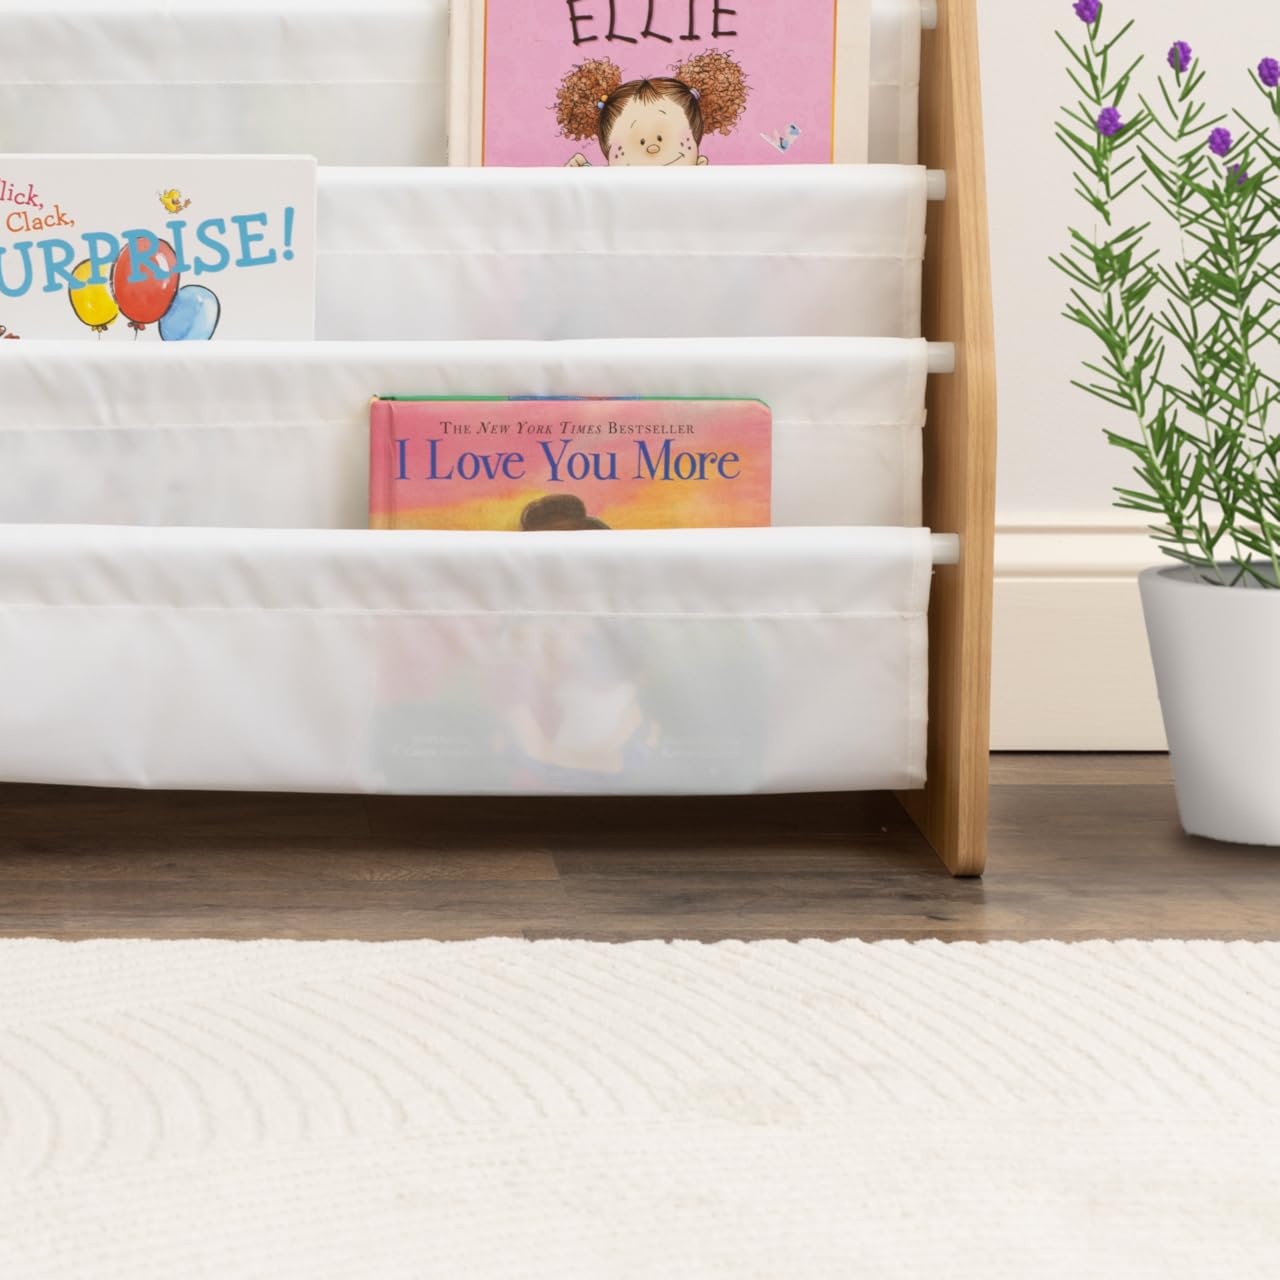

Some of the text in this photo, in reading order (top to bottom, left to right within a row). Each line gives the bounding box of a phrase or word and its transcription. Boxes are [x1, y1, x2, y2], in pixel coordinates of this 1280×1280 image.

[6, 204, 76, 234] Clack,
[440, 421, 695, 434] THE NEW YORK TIMES BESTSELLER
[394, 438, 741, 482] I Love You More
